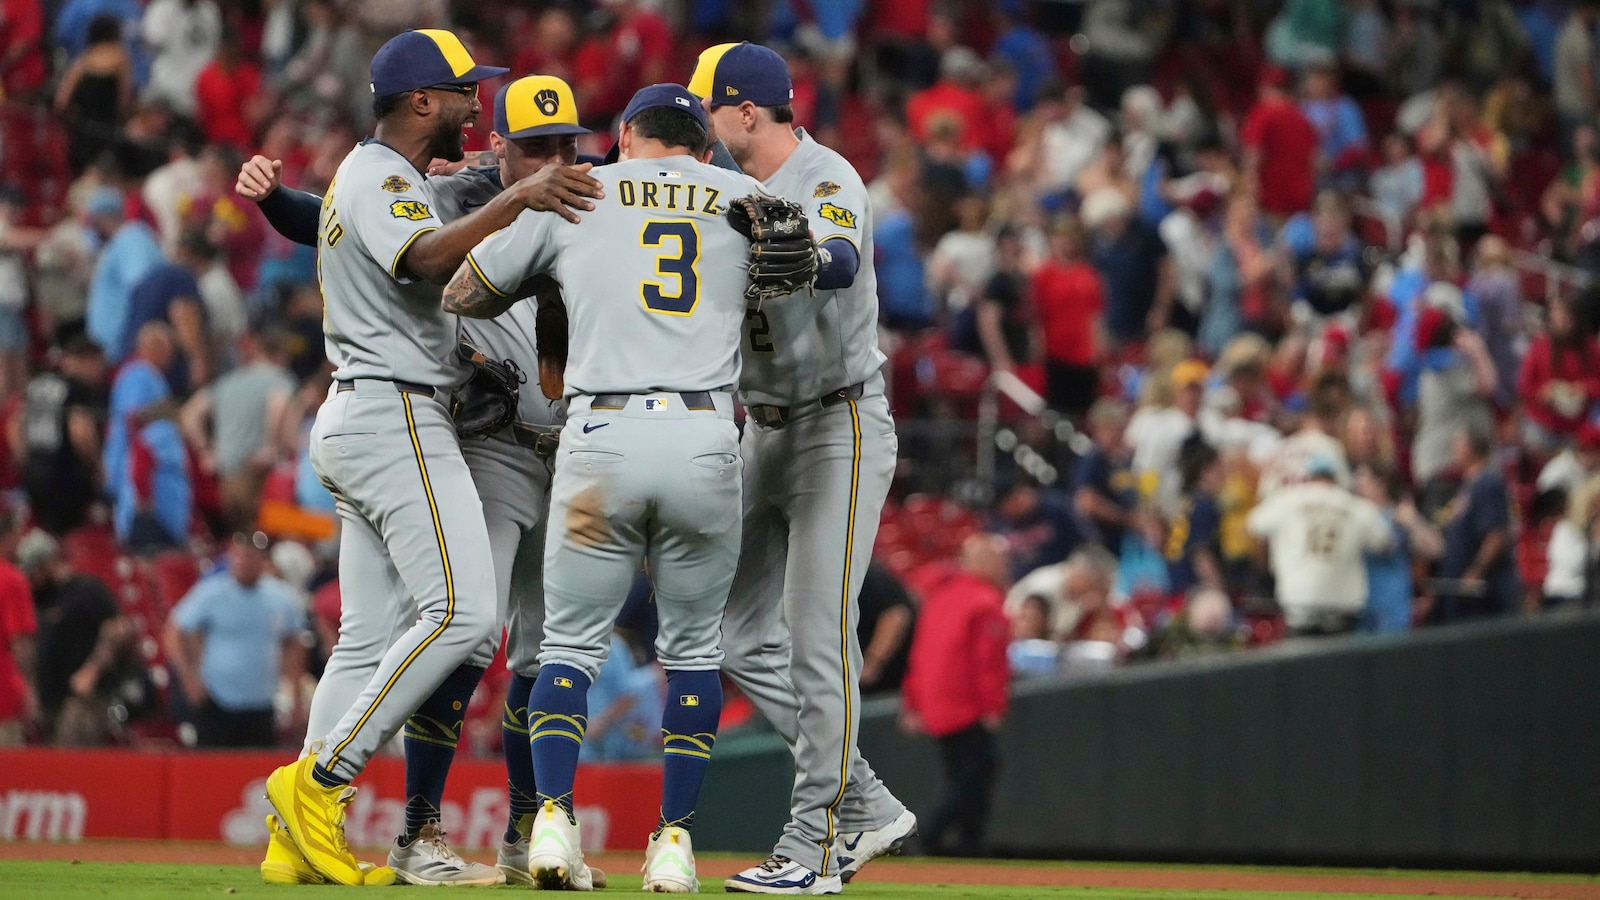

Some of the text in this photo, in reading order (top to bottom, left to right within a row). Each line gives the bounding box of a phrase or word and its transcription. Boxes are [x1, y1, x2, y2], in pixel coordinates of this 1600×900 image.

[618, 179, 720, 217] ORTIZ
[639, 218, 702, 318] 3
[746, 308, 776, 353] 2
[0, 791, 88, 843] rm
